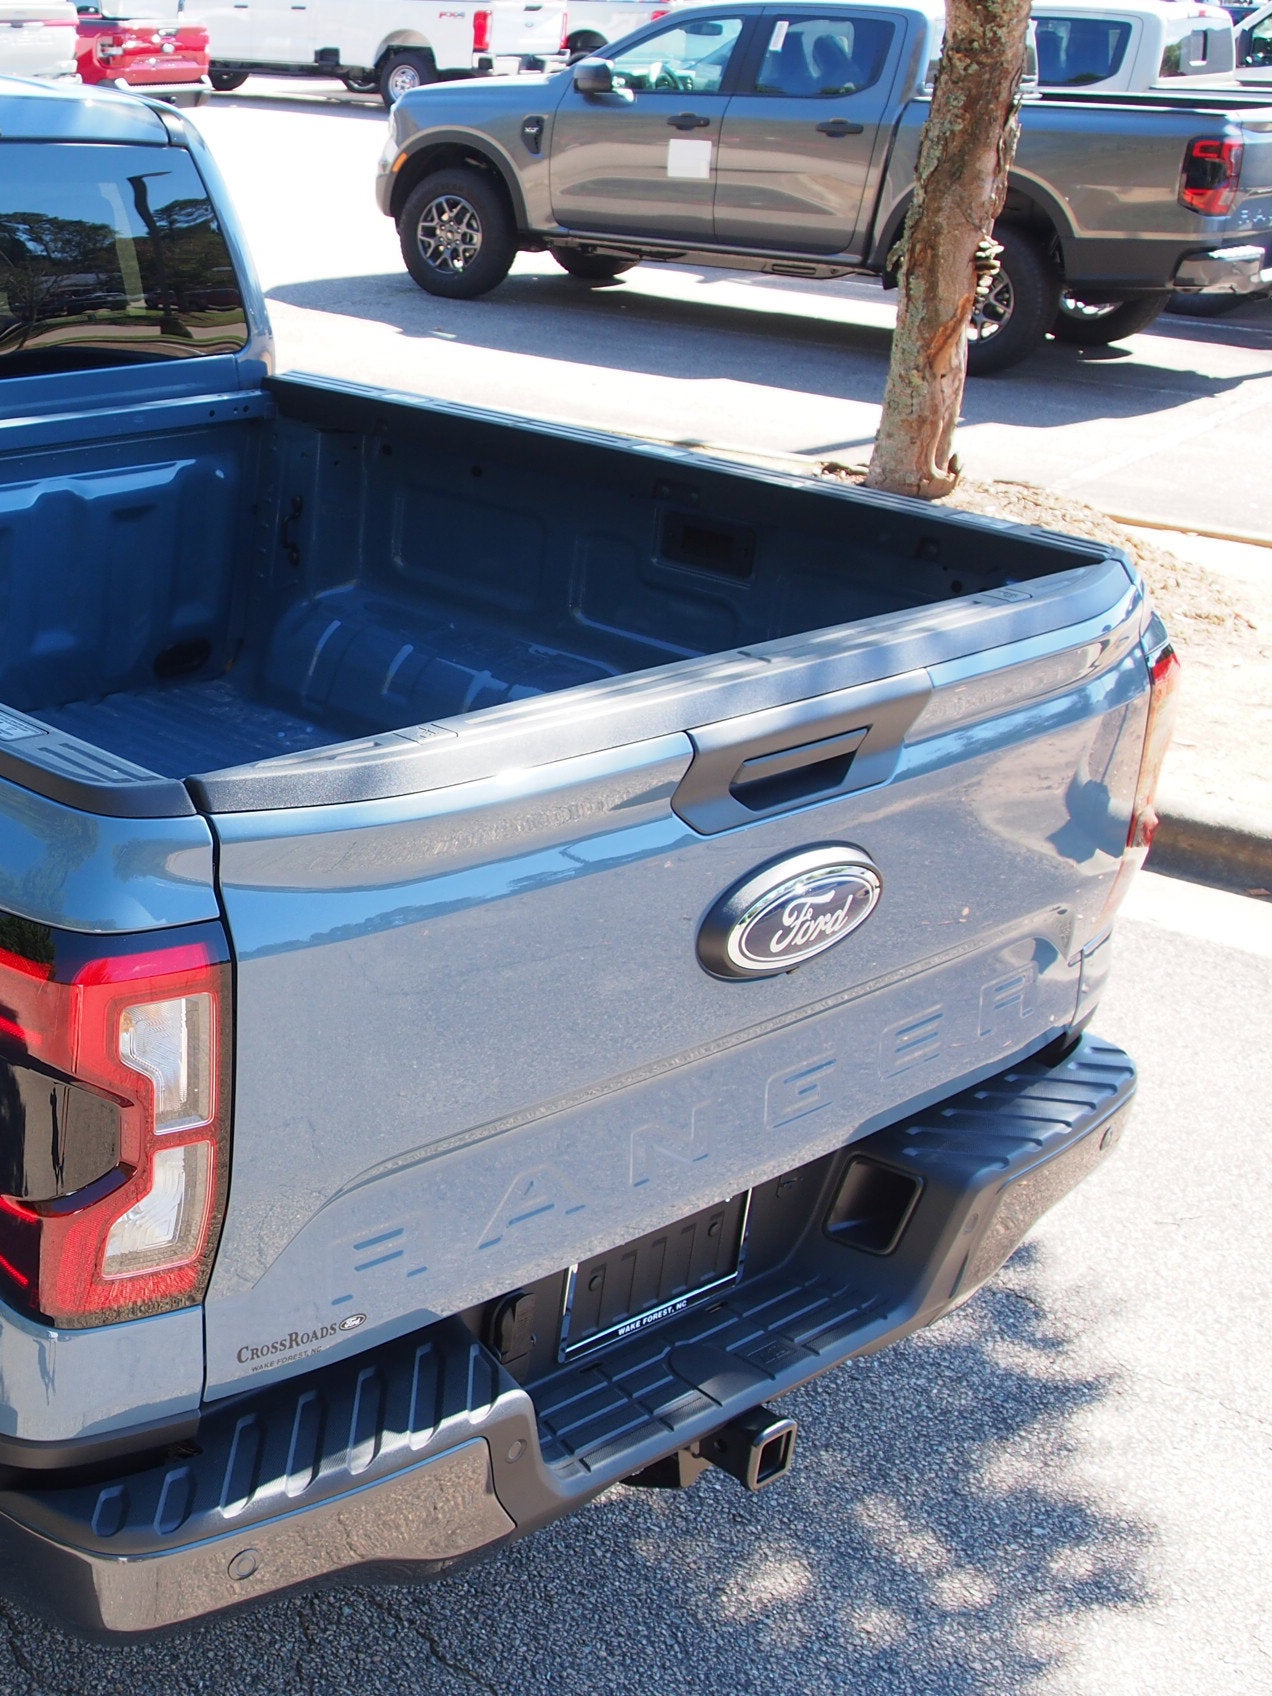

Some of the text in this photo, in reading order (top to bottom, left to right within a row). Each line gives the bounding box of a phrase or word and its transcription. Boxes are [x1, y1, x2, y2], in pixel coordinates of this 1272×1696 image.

[769, 890, 854, 954] Ford
[330, 961, 1039, 1306] RANGER
[618, 1300, 687, 1335] WAKE FOREST, NC
[251, 1361, 275, 1373] WAKE
[310, 1345, 323, 1355] NC
